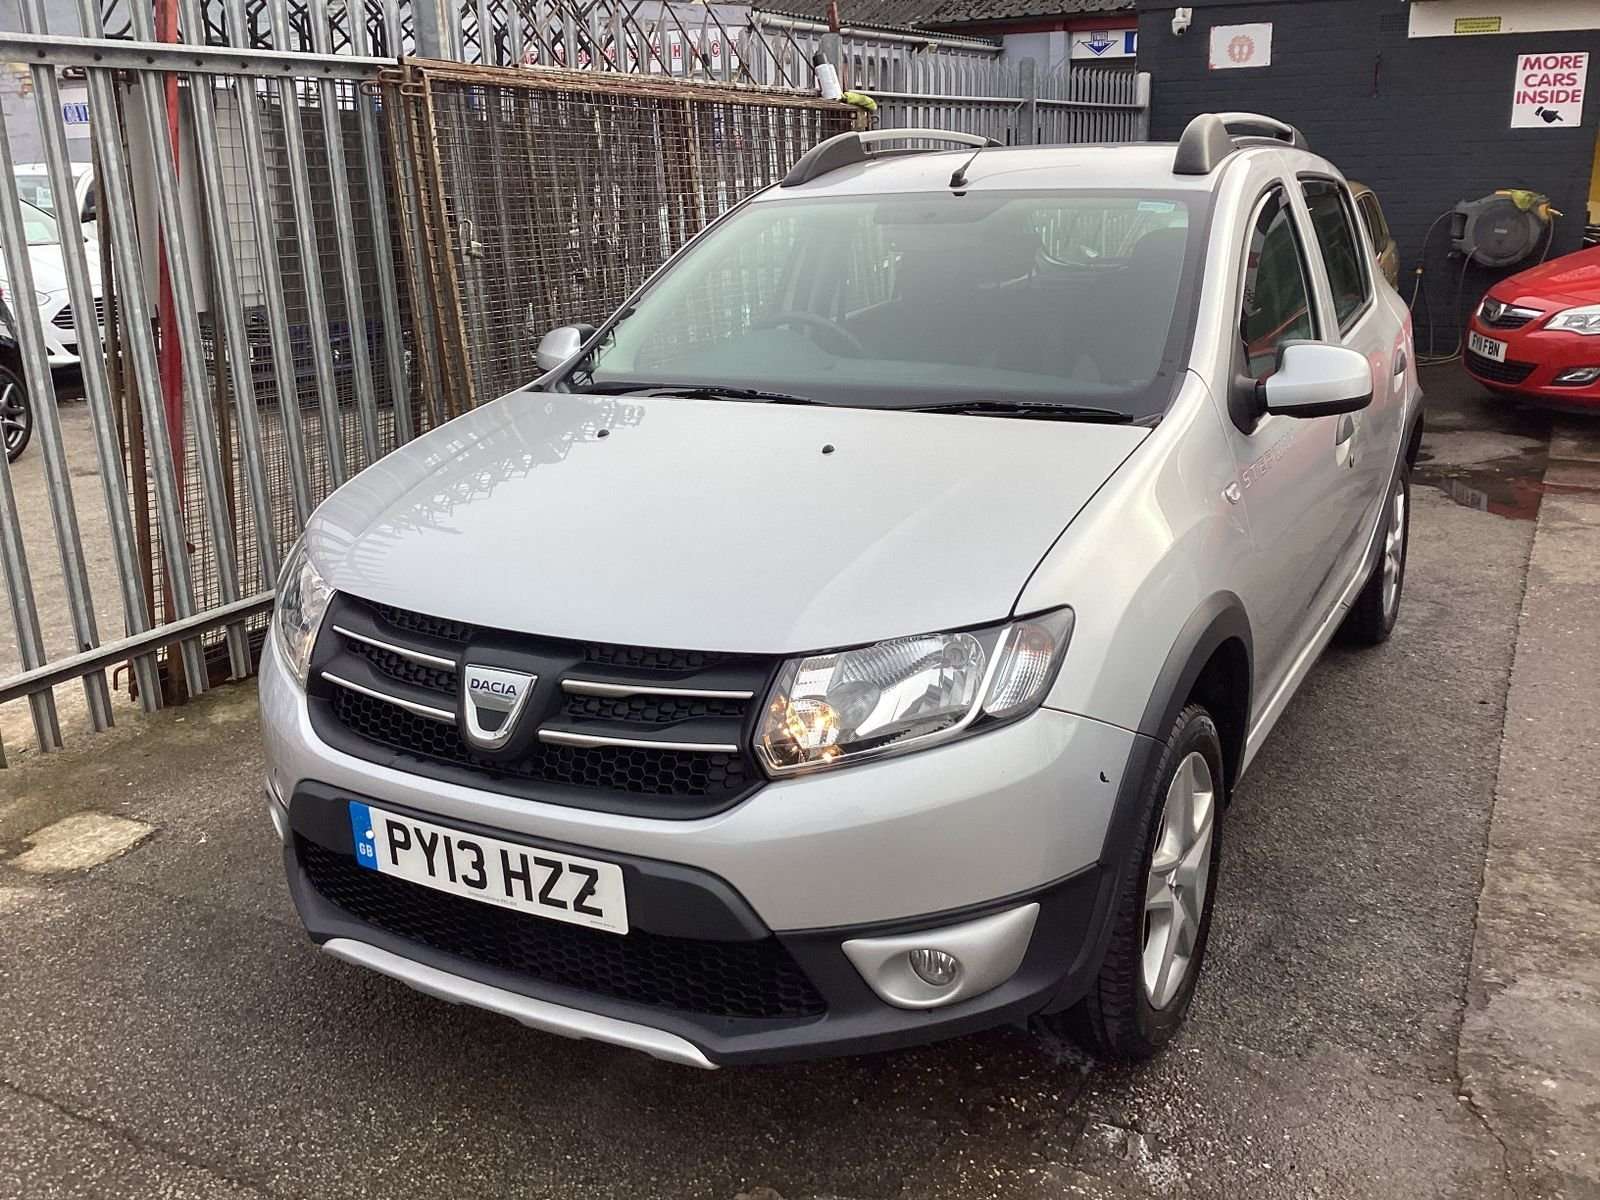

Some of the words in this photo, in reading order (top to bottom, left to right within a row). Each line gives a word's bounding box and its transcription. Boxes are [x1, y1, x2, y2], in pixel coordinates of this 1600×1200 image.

[1522, 54, 1585, 71] MORE
[1523, 72, 1577, 88] CARS
[1516, 89, 1582, 105] INSIDE
[1483, 339, 1501, 358] FBN
[470, 678, 517, 696] DACIA
[359, 842, 374, 857] GB
[385, 818, 488, 890] PY13
[500, 848, 603, 918] HZZ
